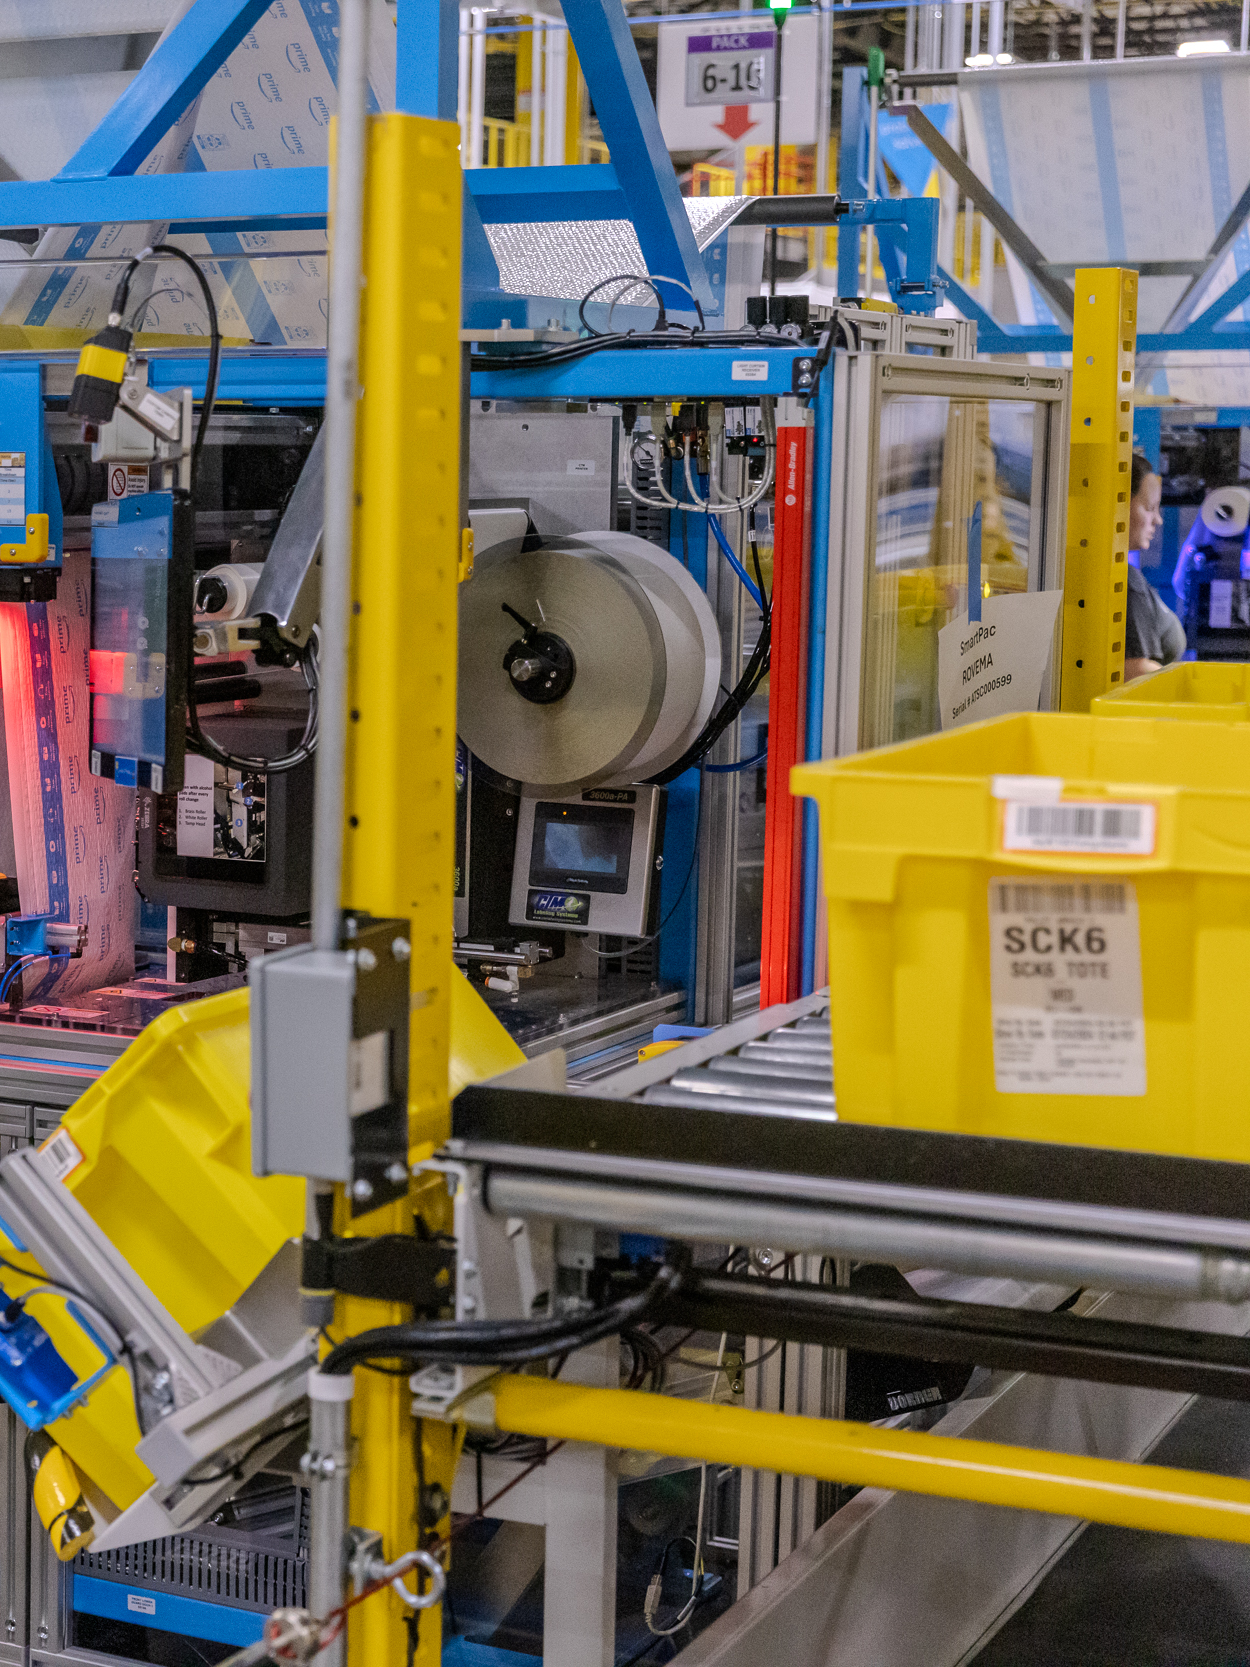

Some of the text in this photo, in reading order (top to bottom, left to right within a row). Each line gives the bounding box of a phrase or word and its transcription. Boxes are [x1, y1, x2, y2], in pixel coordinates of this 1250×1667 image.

[247, 29, 260, 50] ime
[711, 34, 749, 50] PACK
[290, 42, 311, 73] prime
[262, 73, 283, 103] prime
[235, 101, 255, 130] prime
[285, 125, 305, 155] prime
[63, 275, 85, 308] prime
[787, 441, 798, 490] Allen-Bradley
[75, 579, 85, 617] prime
[57, 615, 66, 654] prime
[961, 625, 996, 656] SmartPac
[963, 653, 993, 685] ROVEMA
[63, 685, 72, 724] prime
[953, 674, 1012, 719] Serial # ATSC000599
[68, 755, 77, 795] prime
[94, 787, 103, 825] prime
[590, 791, 628, 800] 3600a-PA
[73, 825, 82, 864] prime
[556, 910, 578, 918] Systems
[1004, 926, 1106, 954] SCK6
[59, 963, 81, 993] prime
[1011, 961, 1109, 979] SCK6 TOTE
